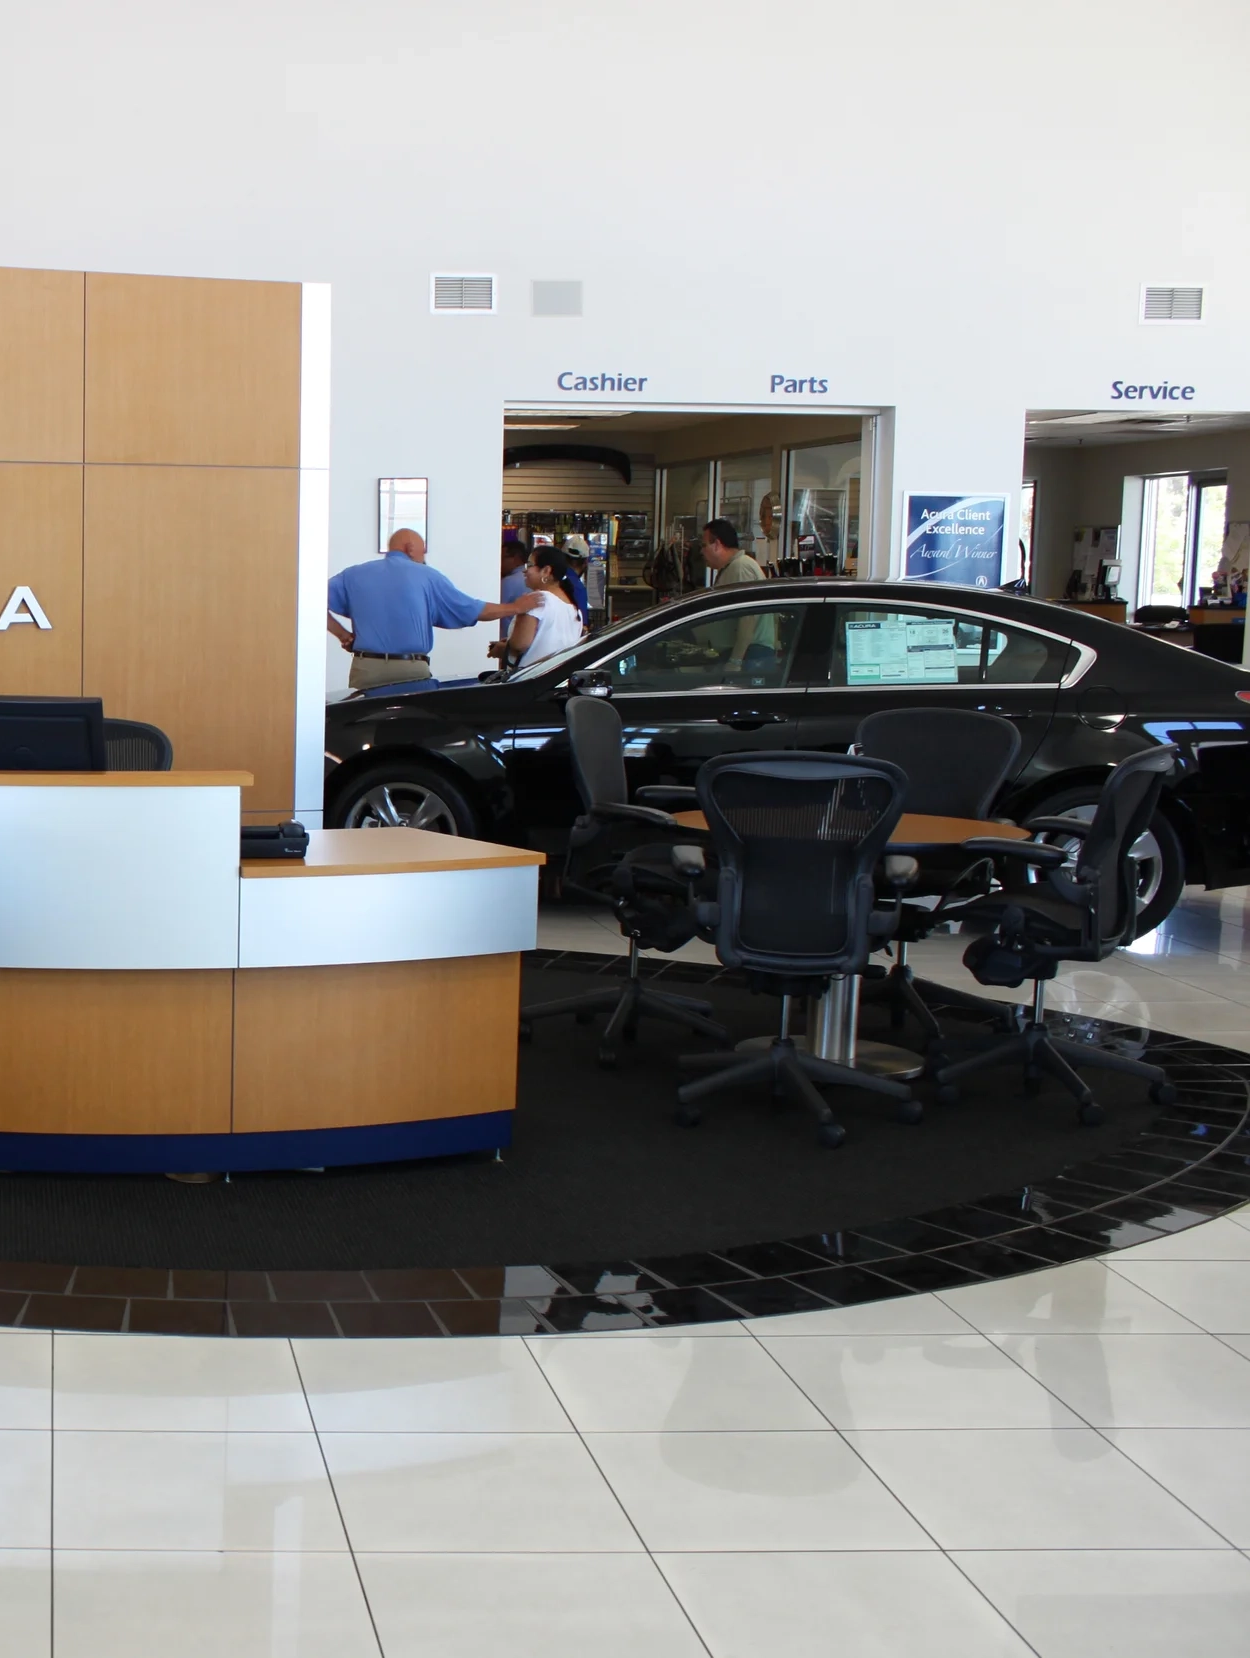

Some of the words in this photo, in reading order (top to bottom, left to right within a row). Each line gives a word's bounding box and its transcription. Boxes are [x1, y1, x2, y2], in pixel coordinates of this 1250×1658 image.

[557, 372, 648, 392] Cashier
[770, 374, 828, 394] Parts
[1111, 380, 1196, 400] Service
[920, 509, 954, 521] Acura
[957, 509, 991, 521] Client
[926, 523, 985, 535] Excellence
[910, 539, 960, 559] Award
[955, 543, 998, 559] Winner
